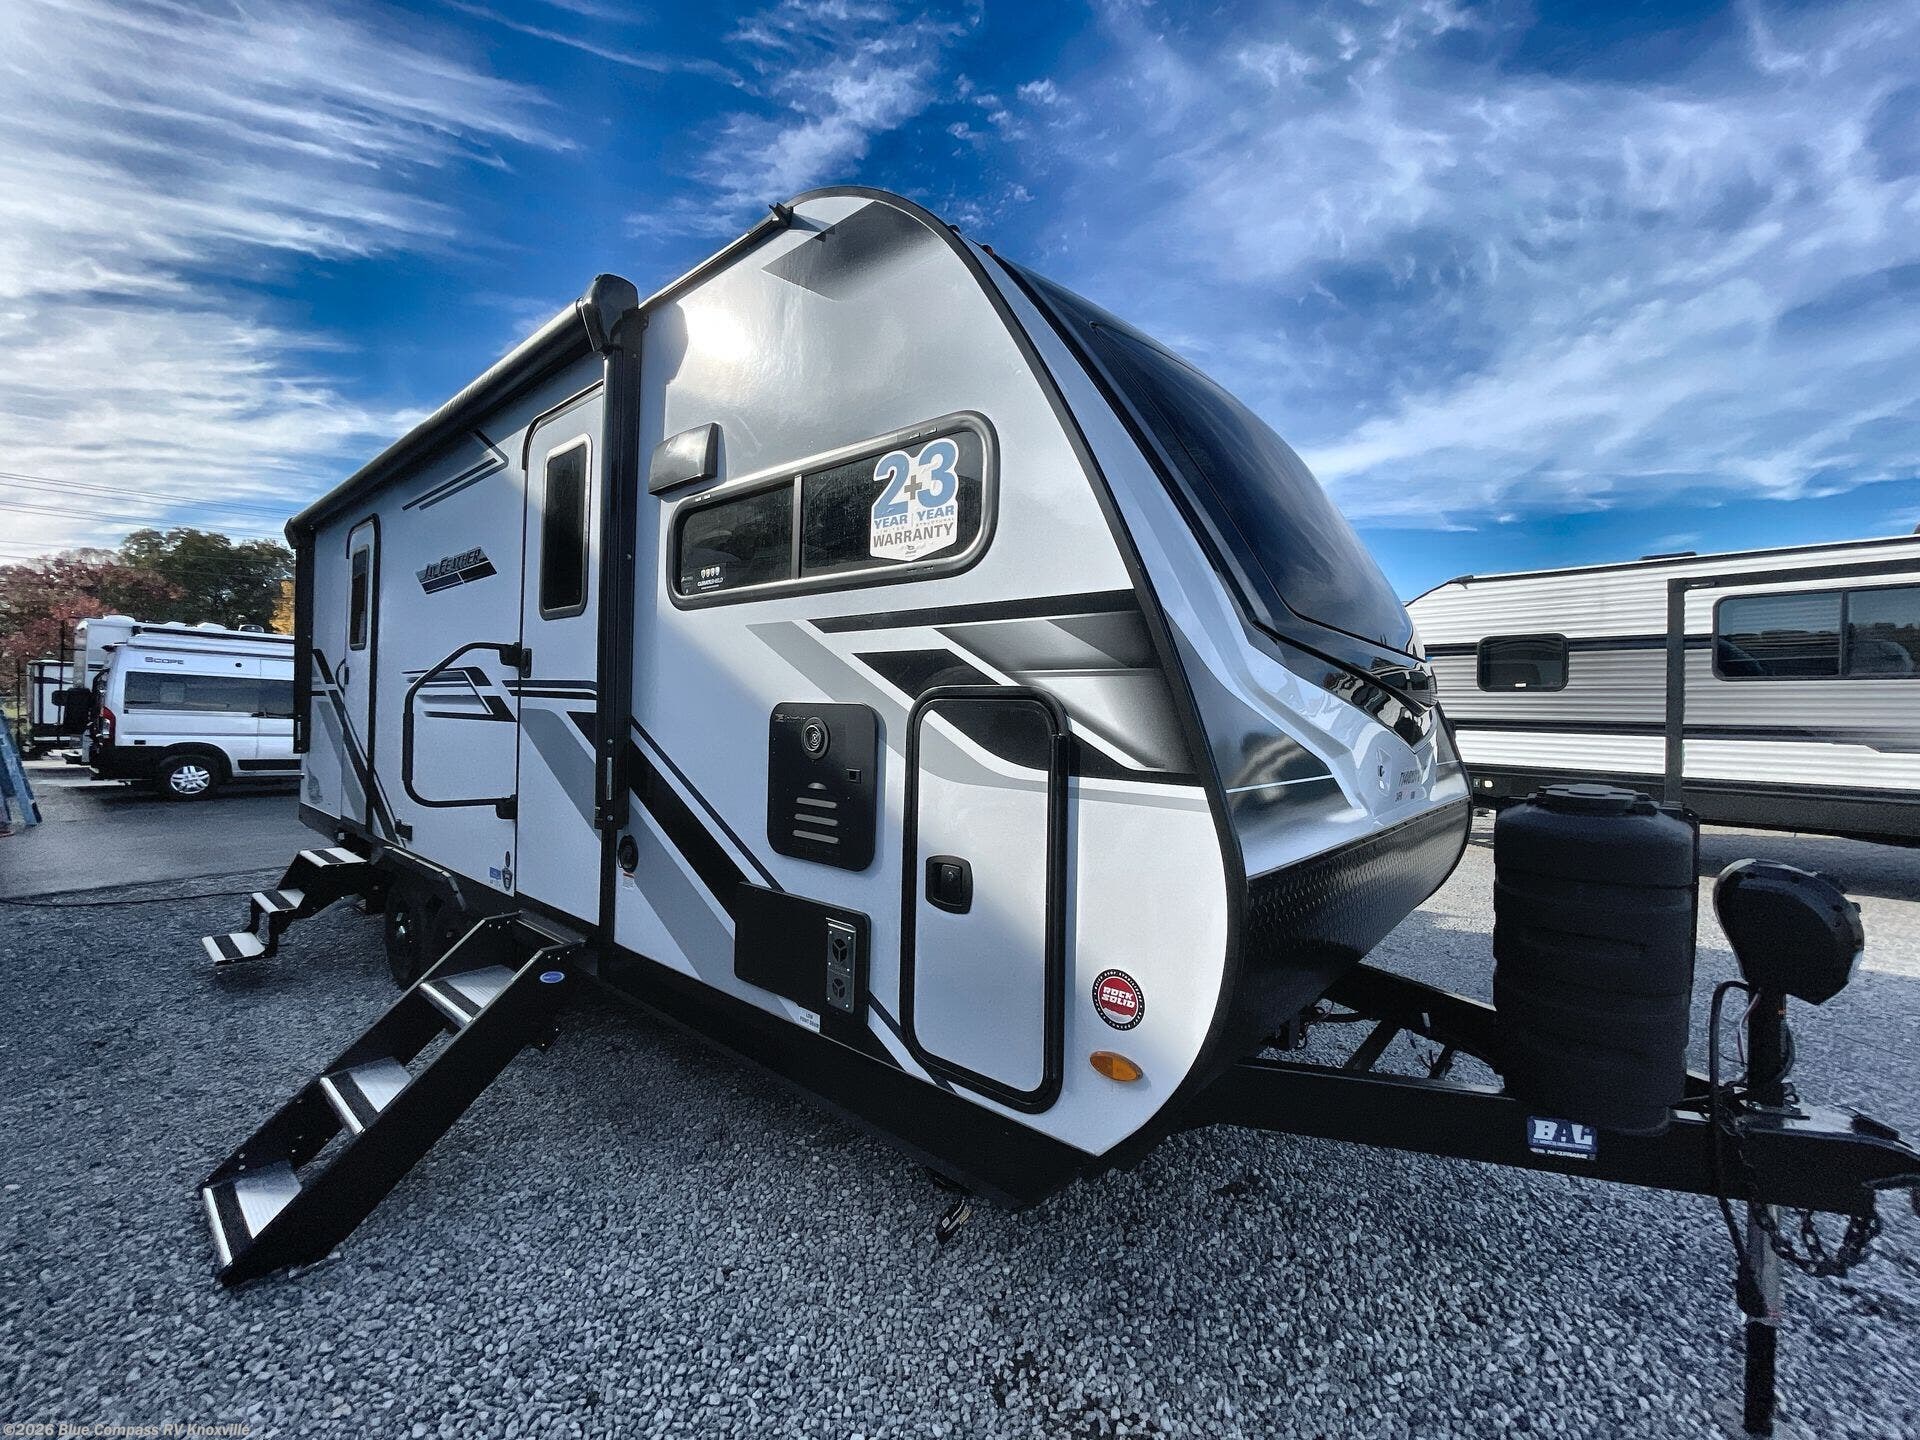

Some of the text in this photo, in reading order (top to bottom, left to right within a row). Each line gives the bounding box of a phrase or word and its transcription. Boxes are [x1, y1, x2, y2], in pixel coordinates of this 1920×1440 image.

[874, 504, 955, 530] YEAR YEAR
[873, 521, 954, 548] WARRANTY
[1101, 993, 1136, 1009] SOLID
[1103, 986, 1134, 1001] ROCK
[1533, 1119, 1593, 1146] BAL
